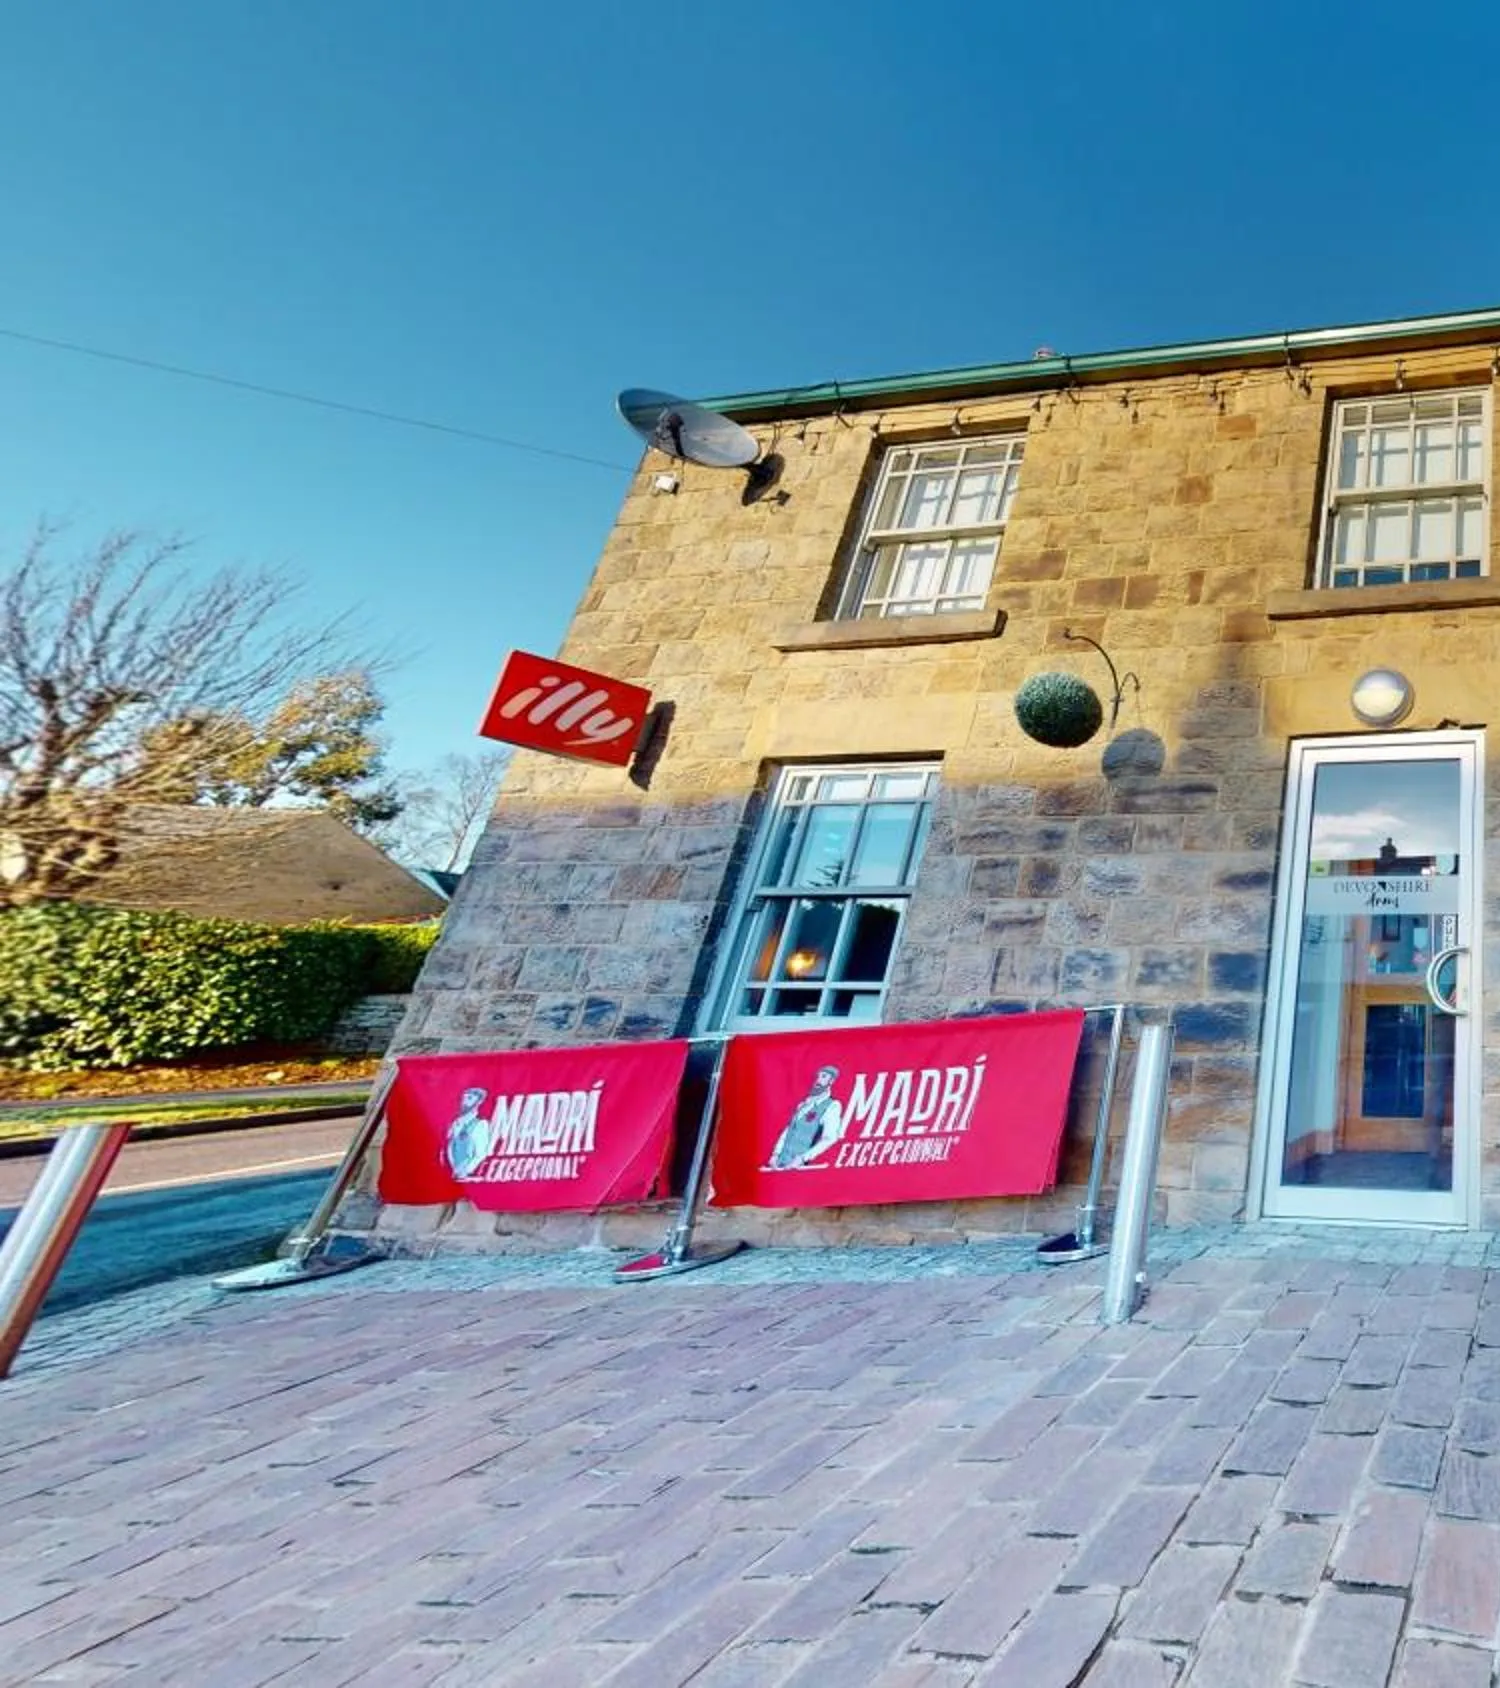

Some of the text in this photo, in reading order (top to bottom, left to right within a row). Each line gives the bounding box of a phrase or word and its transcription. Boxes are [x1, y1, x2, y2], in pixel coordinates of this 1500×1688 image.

[500, 675, 635, 746] illy
[1333, 880, 1431, 894] DEVONSHIRE
[488, 1080, 605, 1156] MADRÍ
[838, 1054, 987, 1139] MADRÍ
